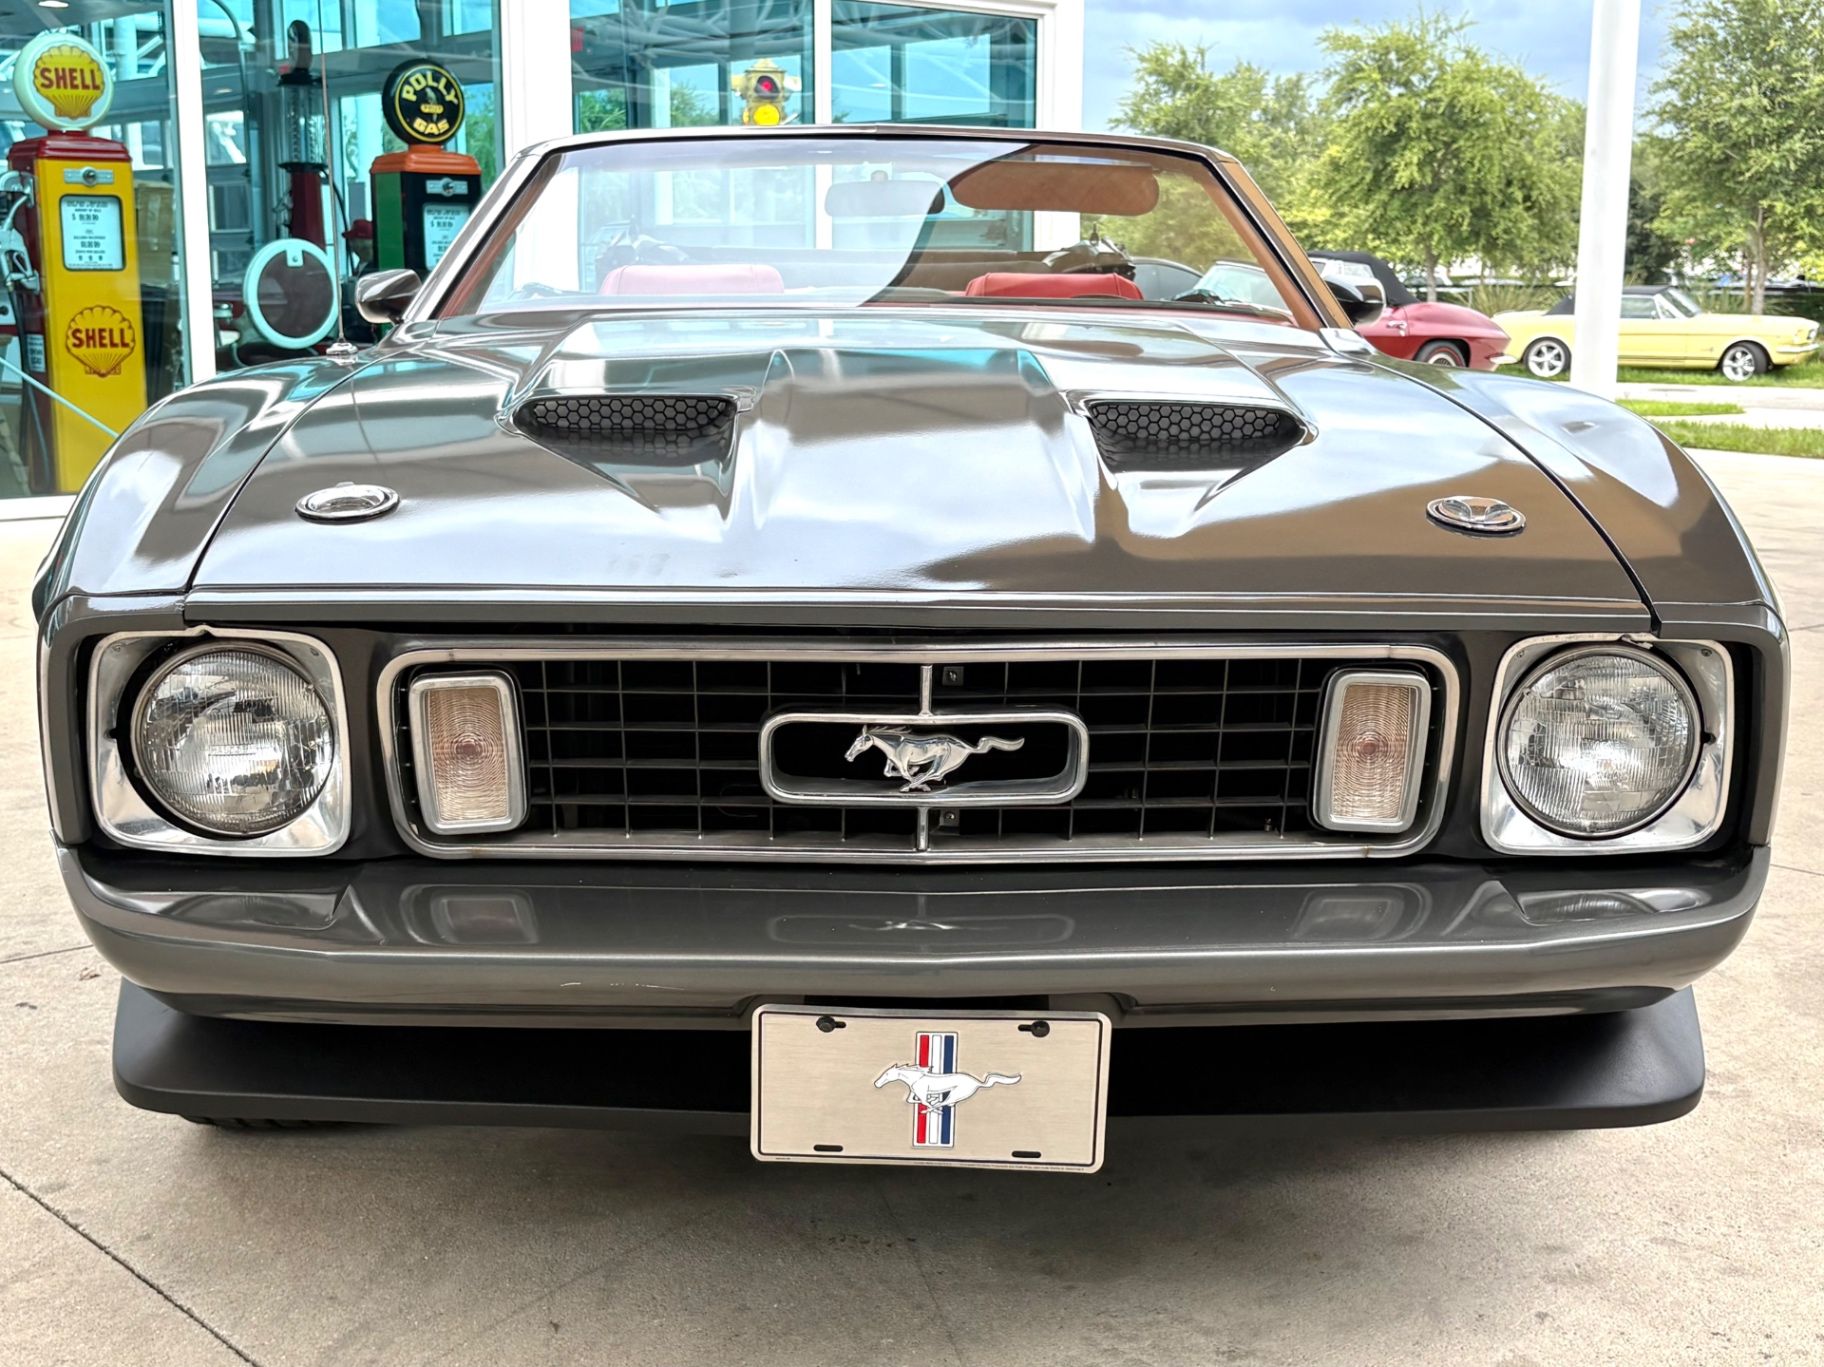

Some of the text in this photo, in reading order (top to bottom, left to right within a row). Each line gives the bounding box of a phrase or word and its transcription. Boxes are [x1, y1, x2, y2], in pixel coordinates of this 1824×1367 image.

[40, 67, 101, 90] SHELL
[402, 71, 458, 104] POLLY
[413, 117, 450, 135] GAS
[71, 328, 130, 348] SHELL
